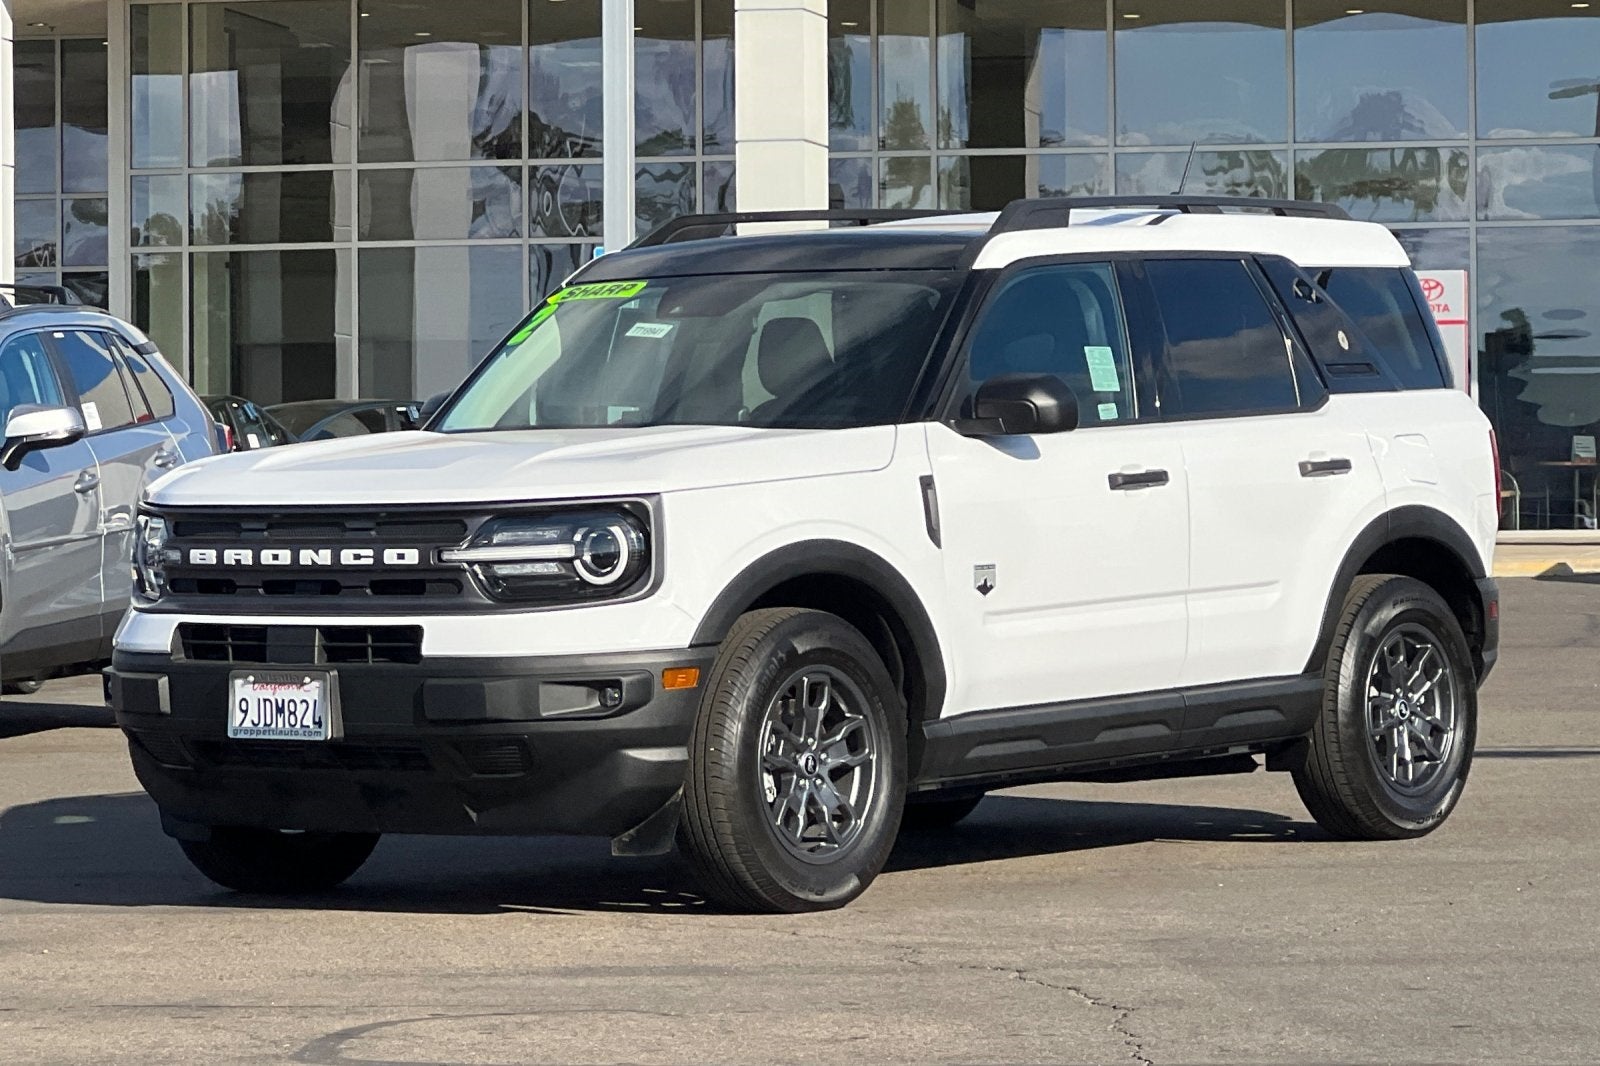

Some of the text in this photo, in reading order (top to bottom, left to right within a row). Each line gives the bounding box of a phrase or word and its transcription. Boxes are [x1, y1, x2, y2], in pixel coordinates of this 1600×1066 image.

[562, 284, 638, 298] SHARP
[189, 548, 419, 565] BRONCO
[239, 697, 323, 729] 9JDM824
[232, 728, 322, 737] groppettiauto.com
